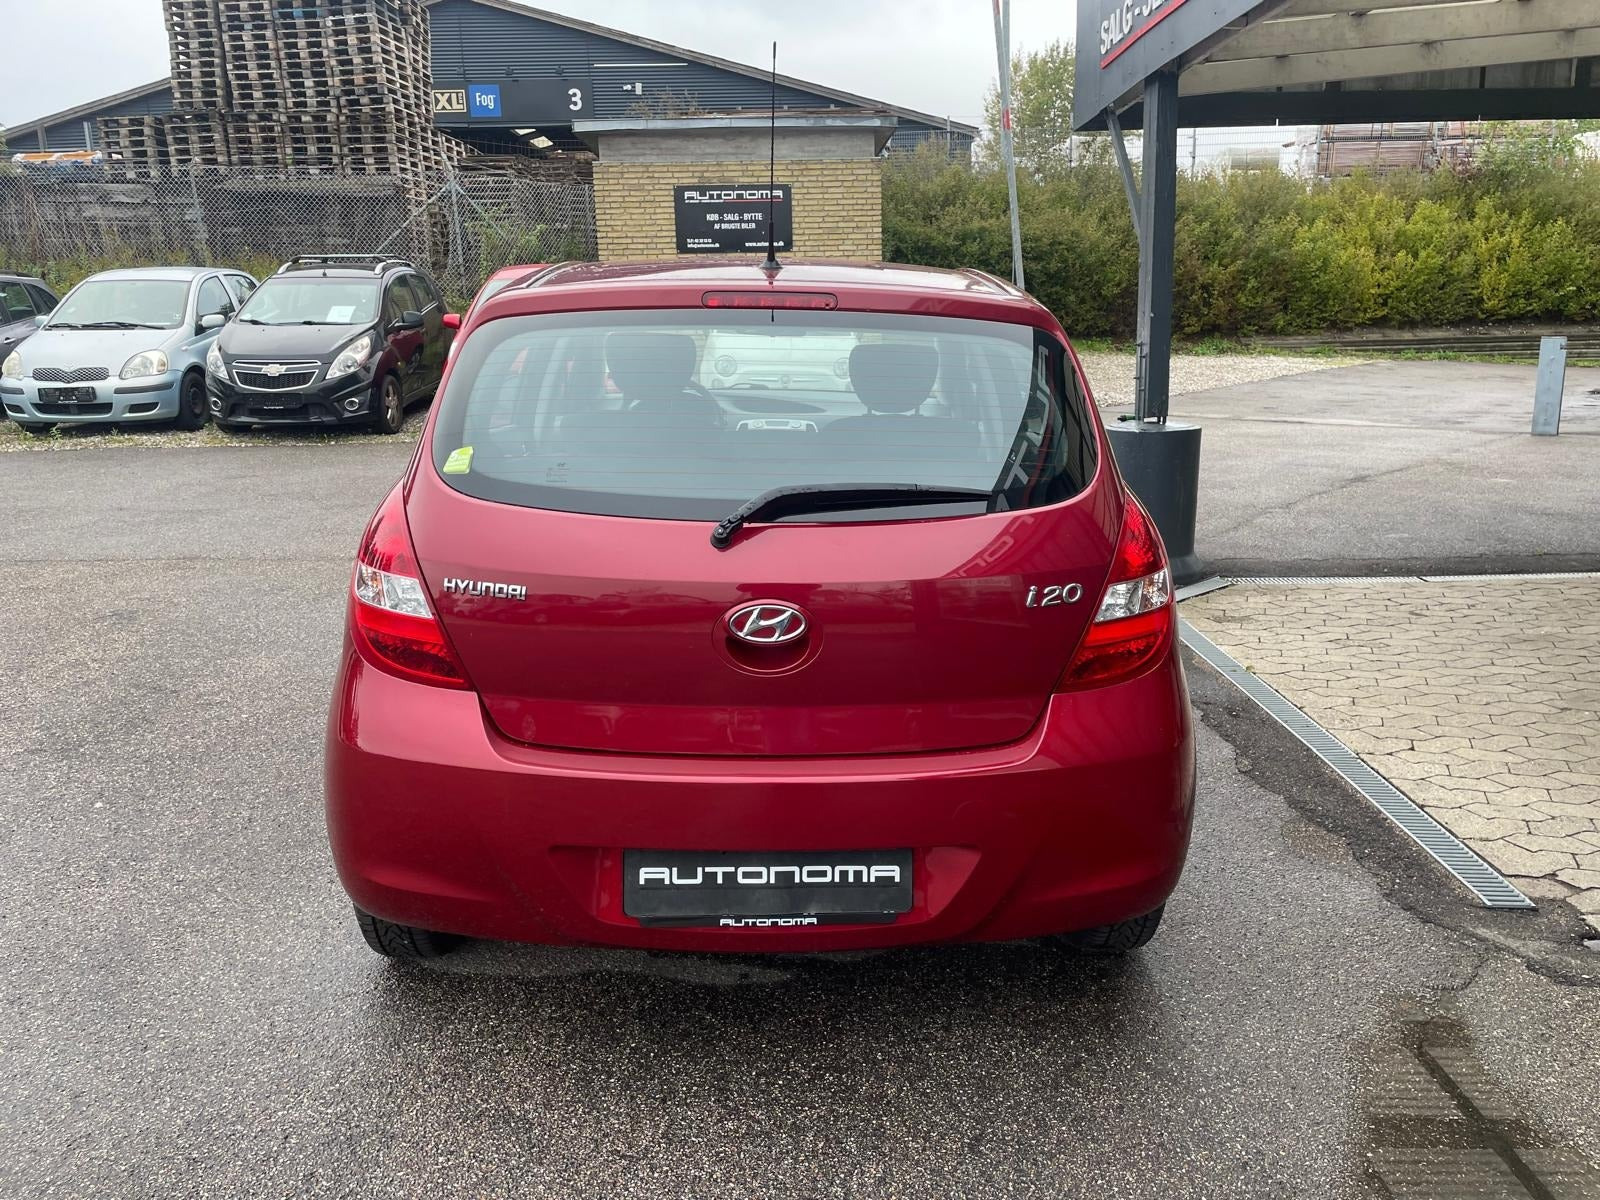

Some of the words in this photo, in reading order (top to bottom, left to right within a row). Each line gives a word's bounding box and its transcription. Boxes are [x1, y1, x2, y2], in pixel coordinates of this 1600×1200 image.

[1100, 0, 1133, 55] SALG
[434, 92, 464, 110] XL
[475, 92, 496, 110] Fog
[567, 88, 583, 111] 3
[684, 190, 783, 199] AUTONOMA
[743, 212, 763, 220] BYTTE
[443, 577, 527, 601] HYUNDAI
[1026, 583, 1083, 608] i20
[639, 865, 900, 885] AUTONOMA
[719, 917, 818, 927] AUTONOMA
